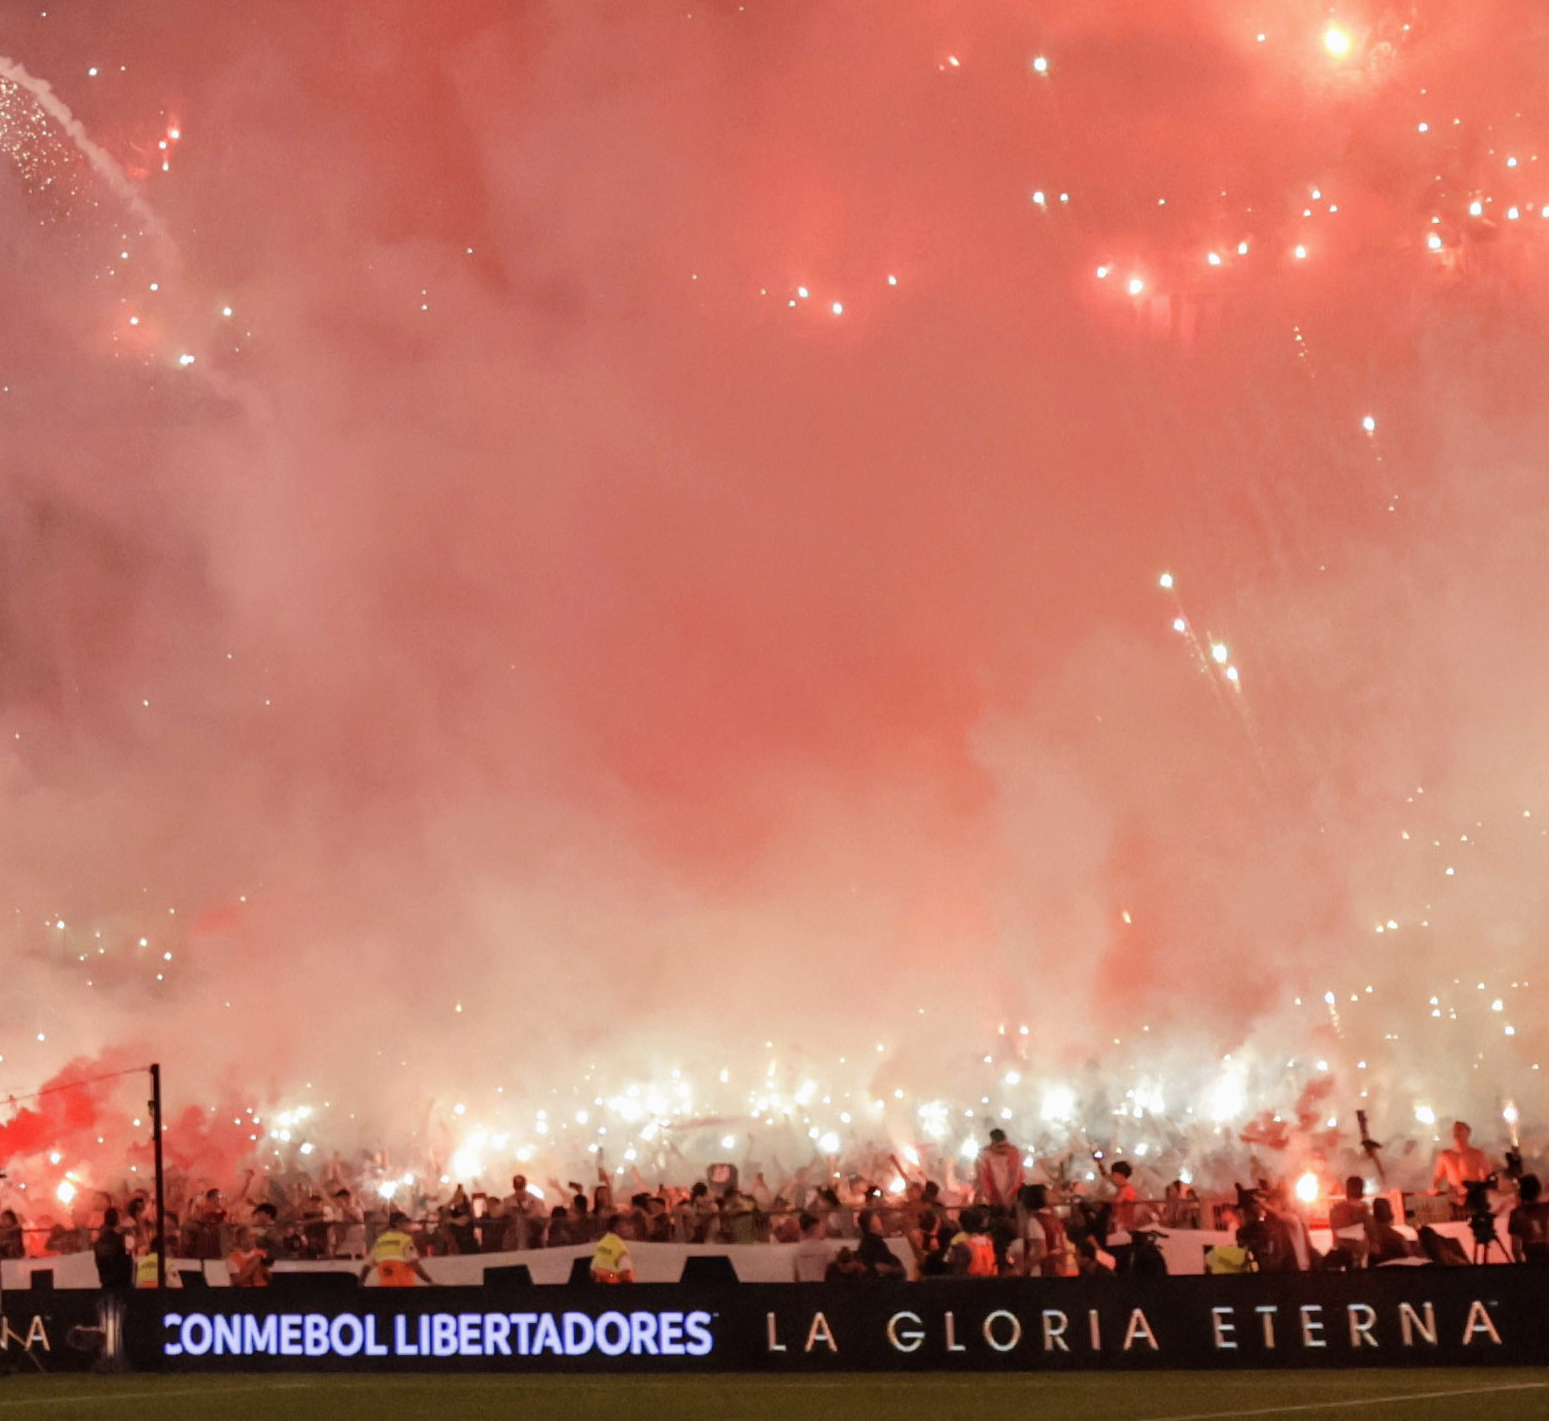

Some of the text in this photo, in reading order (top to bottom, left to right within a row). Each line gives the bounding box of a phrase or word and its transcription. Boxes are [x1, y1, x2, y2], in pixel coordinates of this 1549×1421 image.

[395, 1311, 713, 1356] LIBERTADORES
[768, 1311, 838, 1352] LA
[888, 1308, 1159, 1352] GLORIA
[1212, 1300, 1502, 1349] ETERNA
